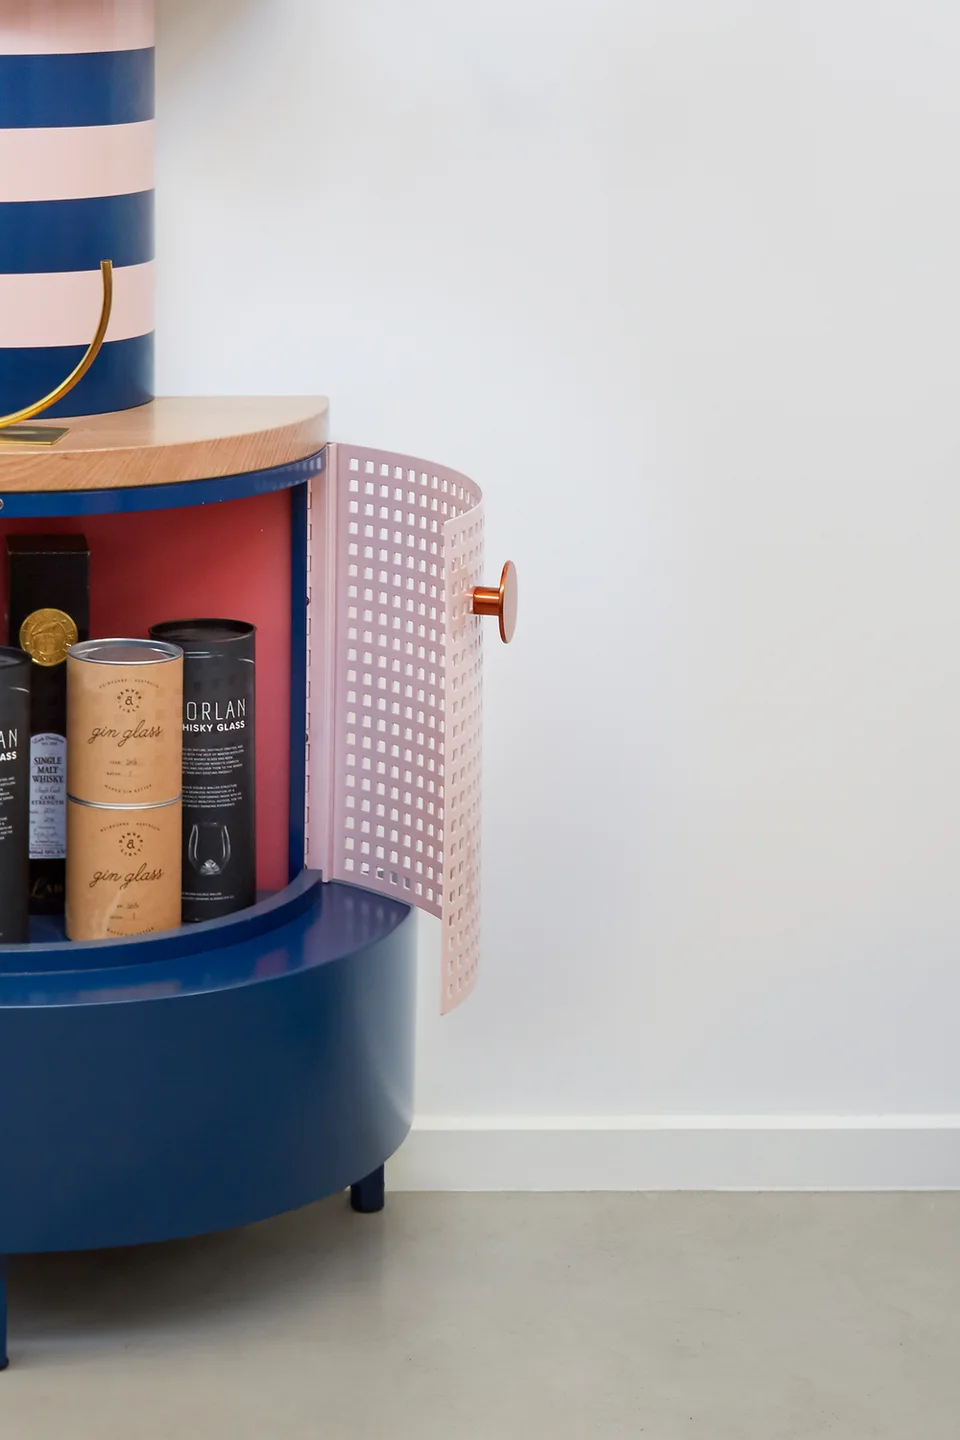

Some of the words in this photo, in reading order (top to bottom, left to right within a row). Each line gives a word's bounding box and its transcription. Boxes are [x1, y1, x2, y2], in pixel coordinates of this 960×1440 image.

[186, 698, 246, 721] ORLAN
[216, 720, 246, 732] GLASS
[87, 726, 120, 744] gin
[117, 719, 164, 747] glass
[33, 757, 62, 765] SINGLE
[37, 766, 59, 774] MALT
[32, 775, 64, 783] WHISKY
[126, 839, 135, 849] &
[89, 869, 122, 888] gin
[120, 862, 164, 890] glass
